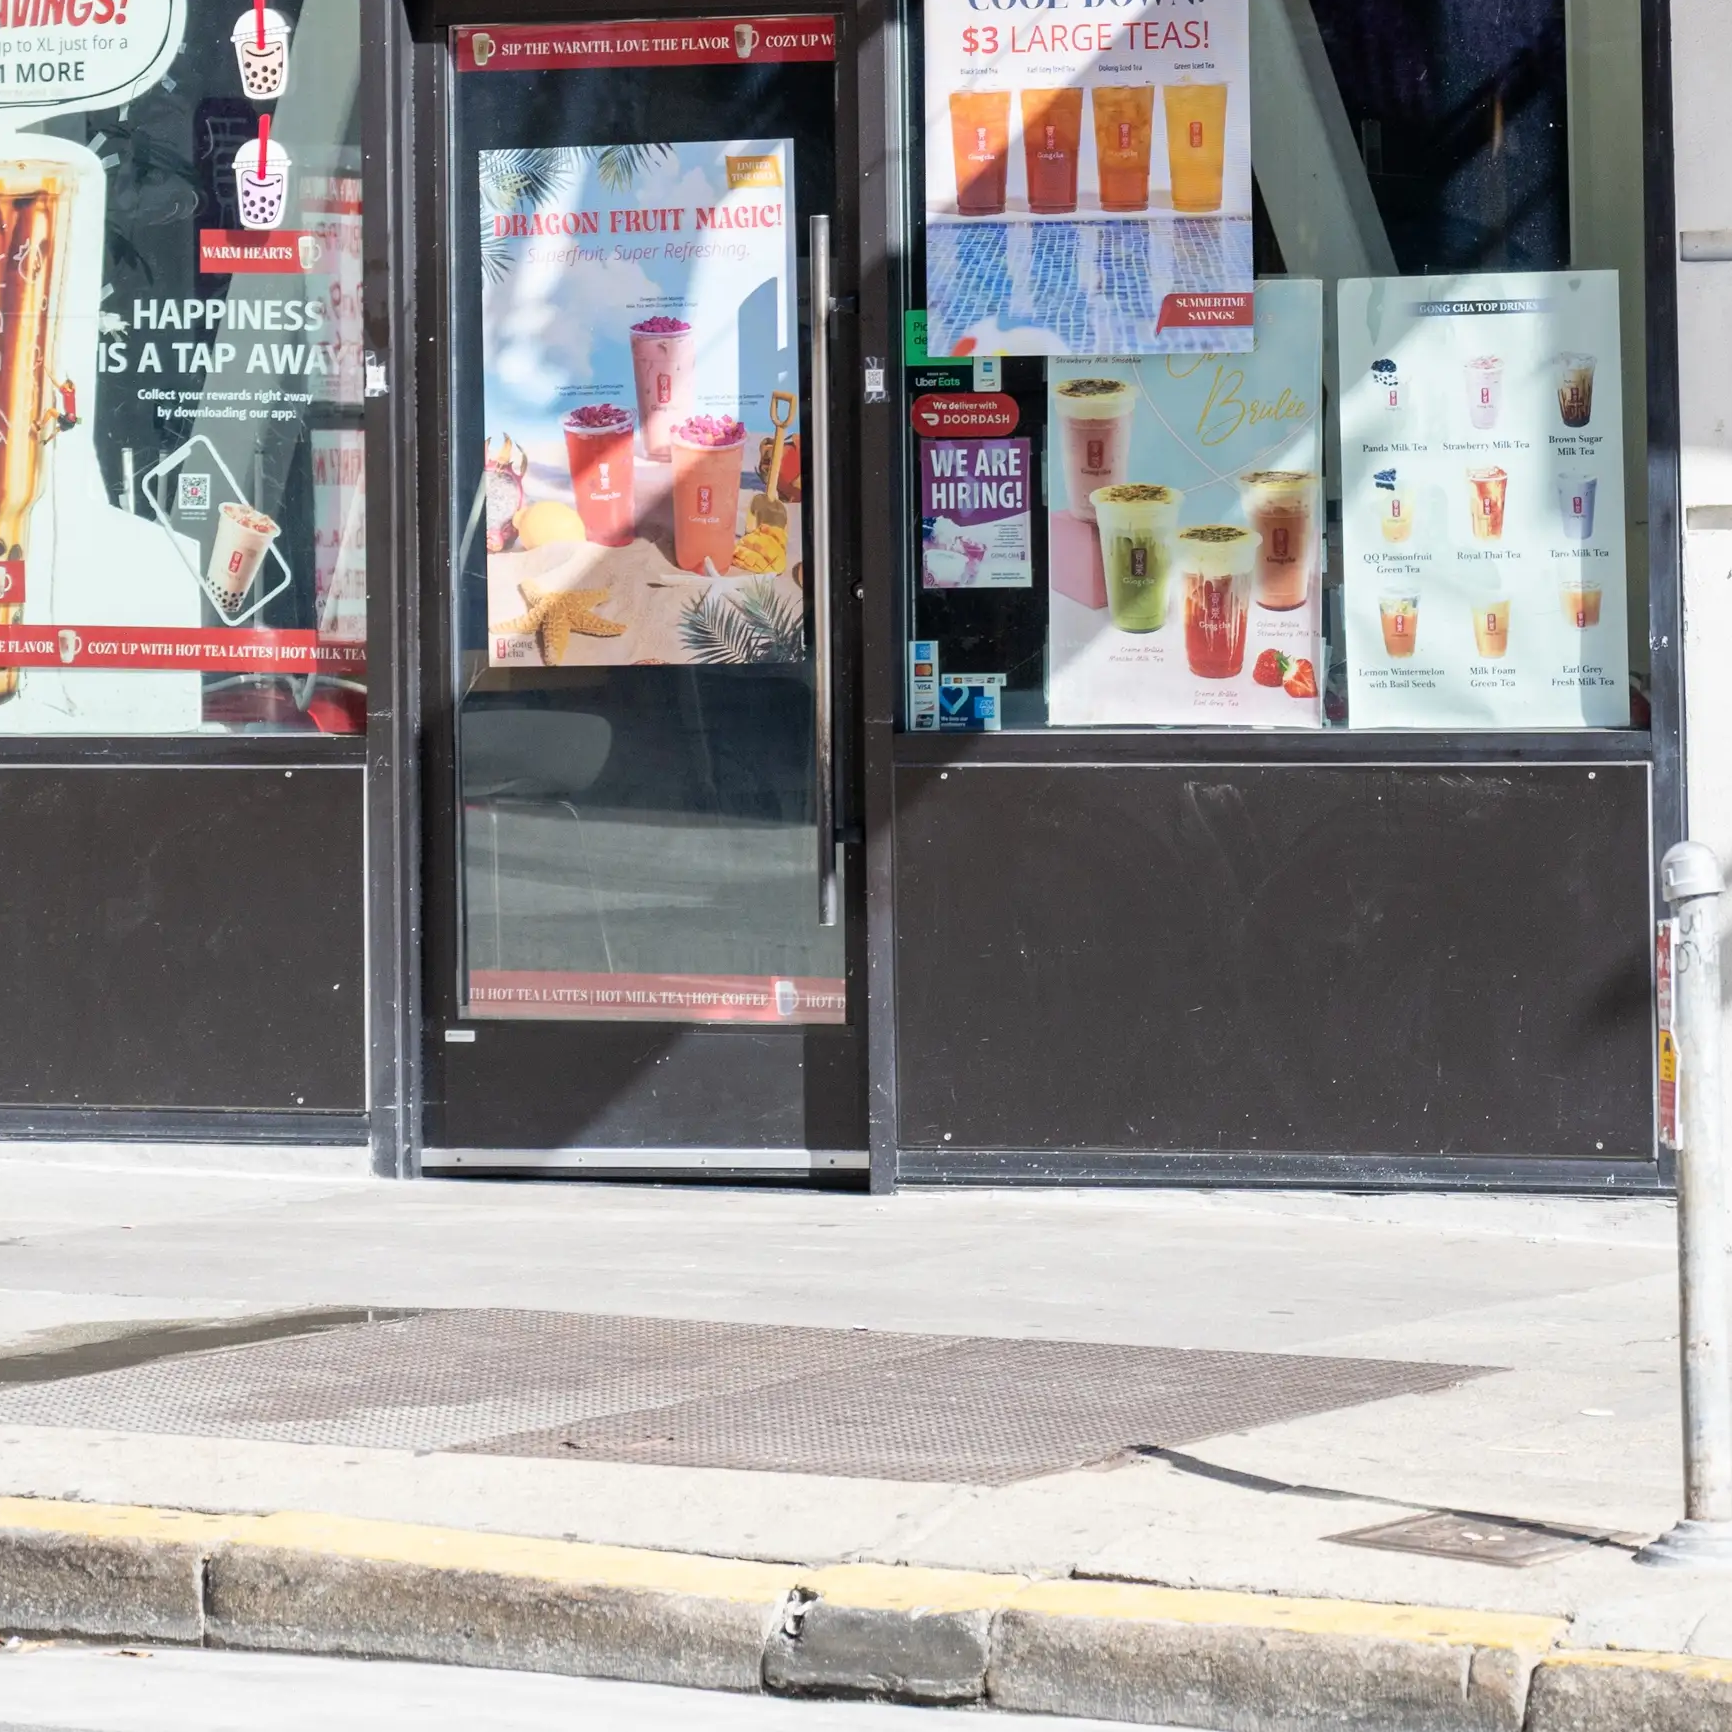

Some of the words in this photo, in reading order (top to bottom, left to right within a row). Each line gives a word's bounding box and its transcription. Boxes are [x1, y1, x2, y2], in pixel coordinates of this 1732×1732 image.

[962, 25, 999, 57] $3
[1011, 23, 1112, 53] LARGE
[1122, 19, 1210, 50] TEAS!
[17, 39, 32, 53] to
[36, 37, 55, 53] XL
[58, 35, 88, 55] just
[92, 35, 113, 50] for
[119, 37, 128, 49] a
[501, 44, 522, 56] SIP
[524, 43, 550, 56] THE
[552, 40, 613, 55] WARMTH,
[616, 39, 650, 53] LOVE
[652, 38, 679, 52] THE
[681, 37, 730, 51] FLAVOR
[765, 35, 799, 49] COZY
[801, 34, 819, 47] UP
[16, 61, 86, 84] MORE
[493, 210, 599, 237] DRAGON
[608, 207, 684, 234] FRUIT
[695, 203, 783, 230] MAGIC!
[202, 246, 241, 259] WARM
[243, 246, 293, 260] HEARTS
[526, 244, 608, 266] Superfruit.
[614, 242, 658, 265] Super
[664, 240, 750, 262] Refreshing.
[1176, 296, 1247, 308] SUMMERTIME
[1419, 303, 1450, 313] GONG
[1452, 302, 1474, 312] CHA
[1476, 302, 1498, 312] TOP
[1499, 301, 1538, 312] DRINKS
[133, 298, 325, 331] HAPPINESS
[1188, 309, 1235, 321] SAVINGS!
[98, 342, 128, 374] IS
[136, 342, 163, 374] A
[171, 343, 236, 374] TAP
[915, 377, 937, 387] Uber
[938, 377, 960, 386] Eats
[137, 388, 176, 401] Collect
[178, 391, 204, 403] your
[206, 389, 252, 402] rewards
[254, 389, 282, 404] right
[283, 393, 313, 405] away
[932, 401, 948, 410] We
[949, 401, 977, 410] deliver
[979, 401, 998, 410] with
[157, 406, 172, 420] by
[174, 406, 247, 421] downloading
[249, 409, 269, 418] our
[943, 414, 1010, 425] DOORDASH
[1442, 440, 1490, 452] Strawberry
[1492, 440, 1513, 450] Milk
[1514, 439, 1530, 449] Tea
[1548, 435, 1576, 445] Brown
[1578, 434, 1603, 446] Sugar
[1362, 443, 1389, 453] Panda
[1390, 443, 1410, 452] Milk
[1411, 442, 1428, 452] Tea
[1557, 446, 1575, 456] Milk
[1577, 446, 1595, 456] Tea
[930, 448, 968, 478] WE
[974, 447, 1022, 477] ARE
[931, 481, 1023, 510] HIRING!
[1363, 552, 1380, 562] QQ
[1382, 551, 1433, 562] Passionfruit
[1456, 551, 1482, 561] Royal
[1482, 550, 1504, 560] Thai
[1505, 550, 1522, 560] Tea
[1550, 549, 1570, 558] Taro
[1571, 549, 1591, 558] Milk
[1592, 549, 1610, 558] Tea
[1376, 565, 1403, 574] Green
[1404, 565, 1421, 574] Tea
[8, 640, 55, 654] FLAVOR
[87, 641, 119, 655] COZY
[121, 642, 138, 655] UP
[140, 643, 173, 656] WITH
[175, 644, 201, 657] HOT
[203, 644, 226, 657] TEA
[229, 645, 273, 658] LATTES
[281, 646, 308, 659] HOT
[309, 647, 341, 660] MILK
[343, 648, 367, 661] TEA
[1359, 668, 1388, 677] Lemon
[1390, 667, 1445, 677] Wintermelon
[1470, 667, 1490, 675] Milk
[1491, 667, 1516, 676] Foam
[1562, 665, 1580, 674] Earl
[1582, 665, 1603, 677] Grey
[1369, 679, 1388, 689] with
[1389, 679, 1409, 689] Basil
[1411, 679, 1436, 689] Seeds
[1470, 679, 1497, 688] Green
[1499, 679, 1516, 687] Tea
[1551, 677, 1575, 687] Fresh
[1577, 677, 1597, 687] Milk
[1599, 677, 1615, 687] Tea
[487, 987, 515, 1000] HOT
[516, 988, 540, 1001] TEA
[542, 988, 588, 1002] LATTES
[596, 990, 624, 1003] HOT
[626, 991, 657, 1004] MILK
[692, 992, 720, 1005] HOT
[722, 993, 769, 1007] COFFEE
[806, 995, 836, 1008] HOT
